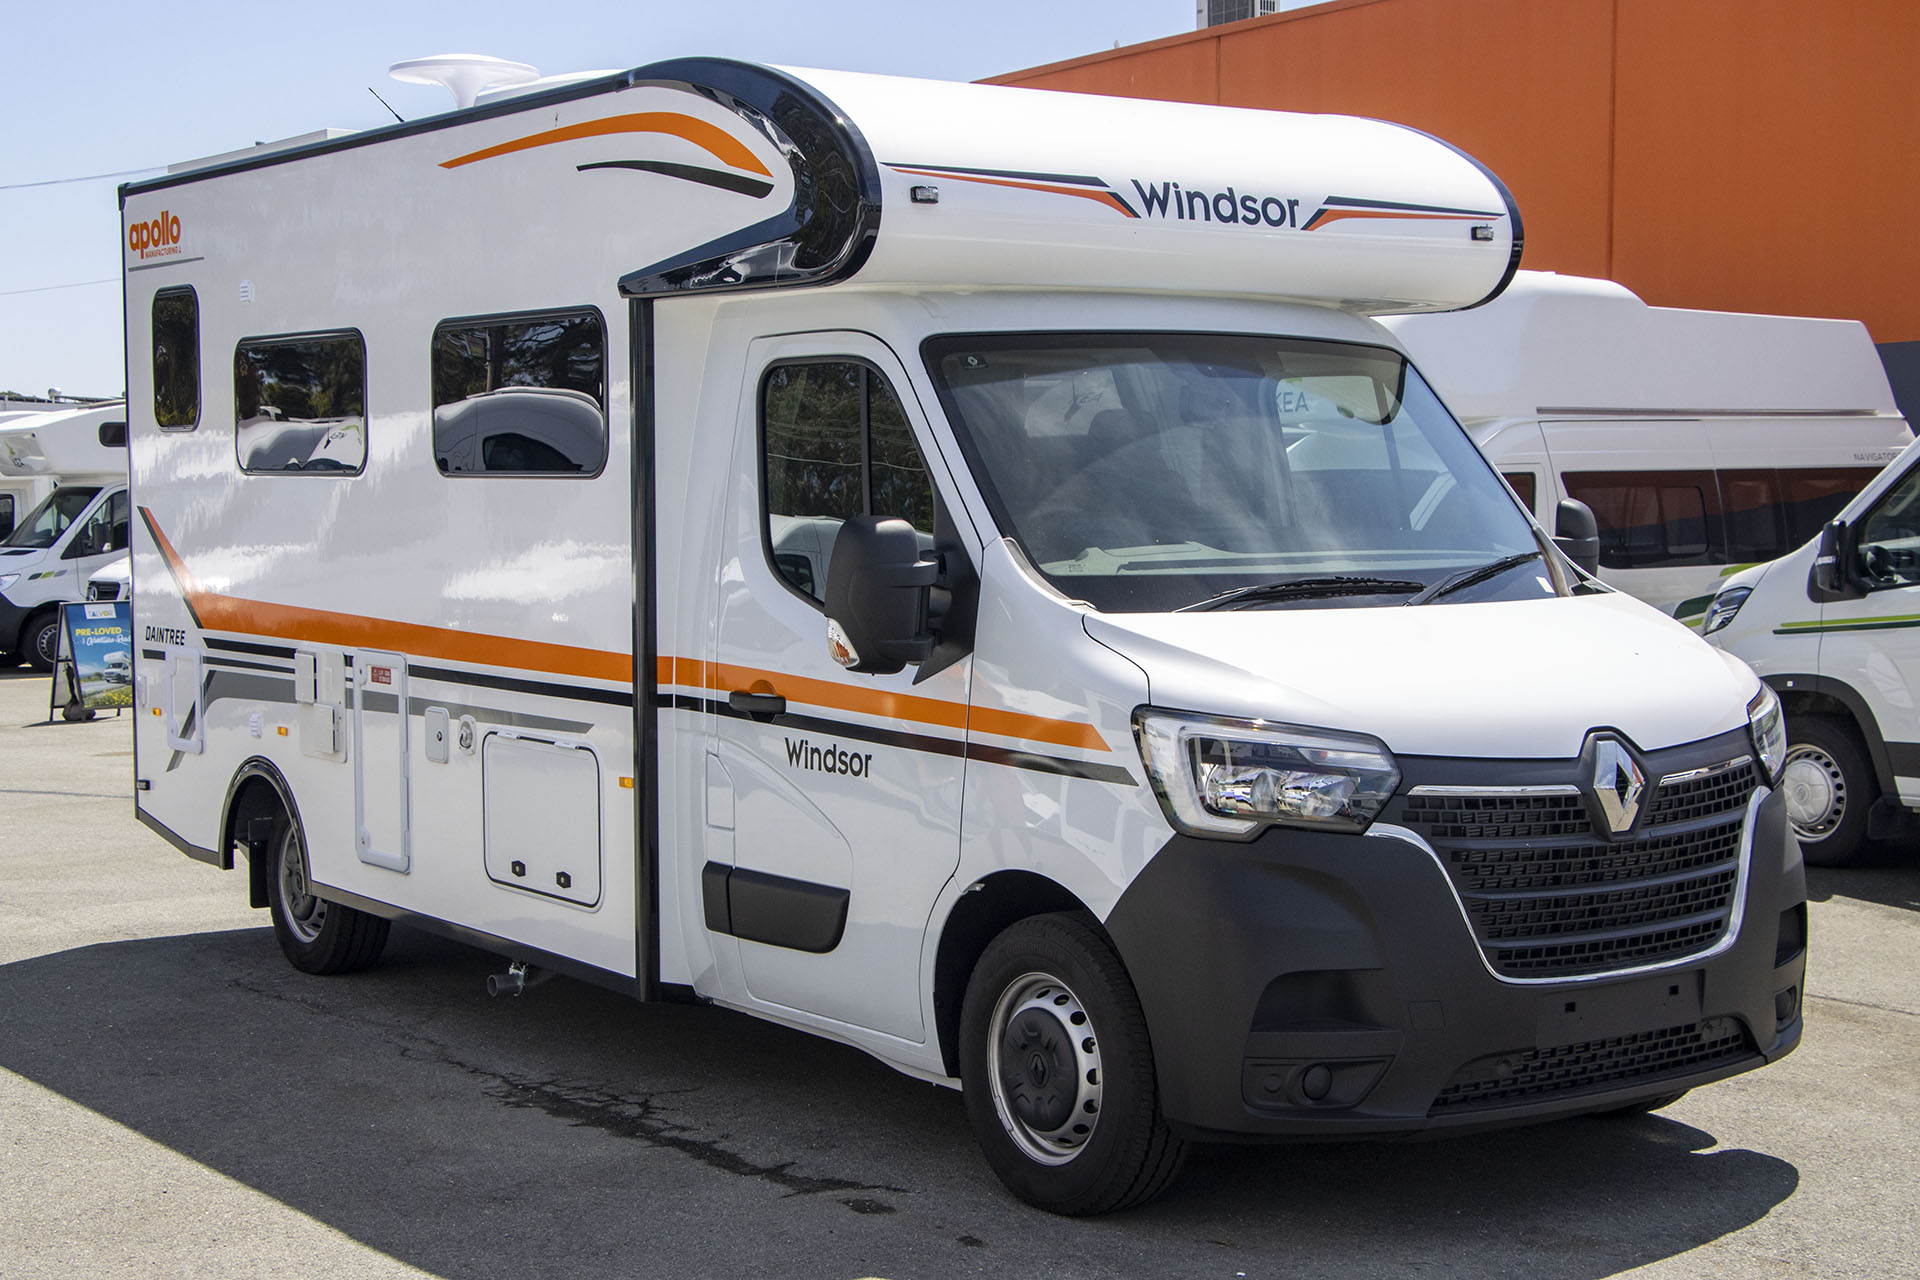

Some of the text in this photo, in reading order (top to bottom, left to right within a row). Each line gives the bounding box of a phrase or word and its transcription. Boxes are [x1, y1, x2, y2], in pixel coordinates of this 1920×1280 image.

[1130, 178, 1300, 228] Windsor
[129, 209, 181, 260] apollo
[75, 626, 122, 637] PRE-LOVED
[145, 625, 186, 646] DAINTREE
[784, 736, 873, 778] Windsor
